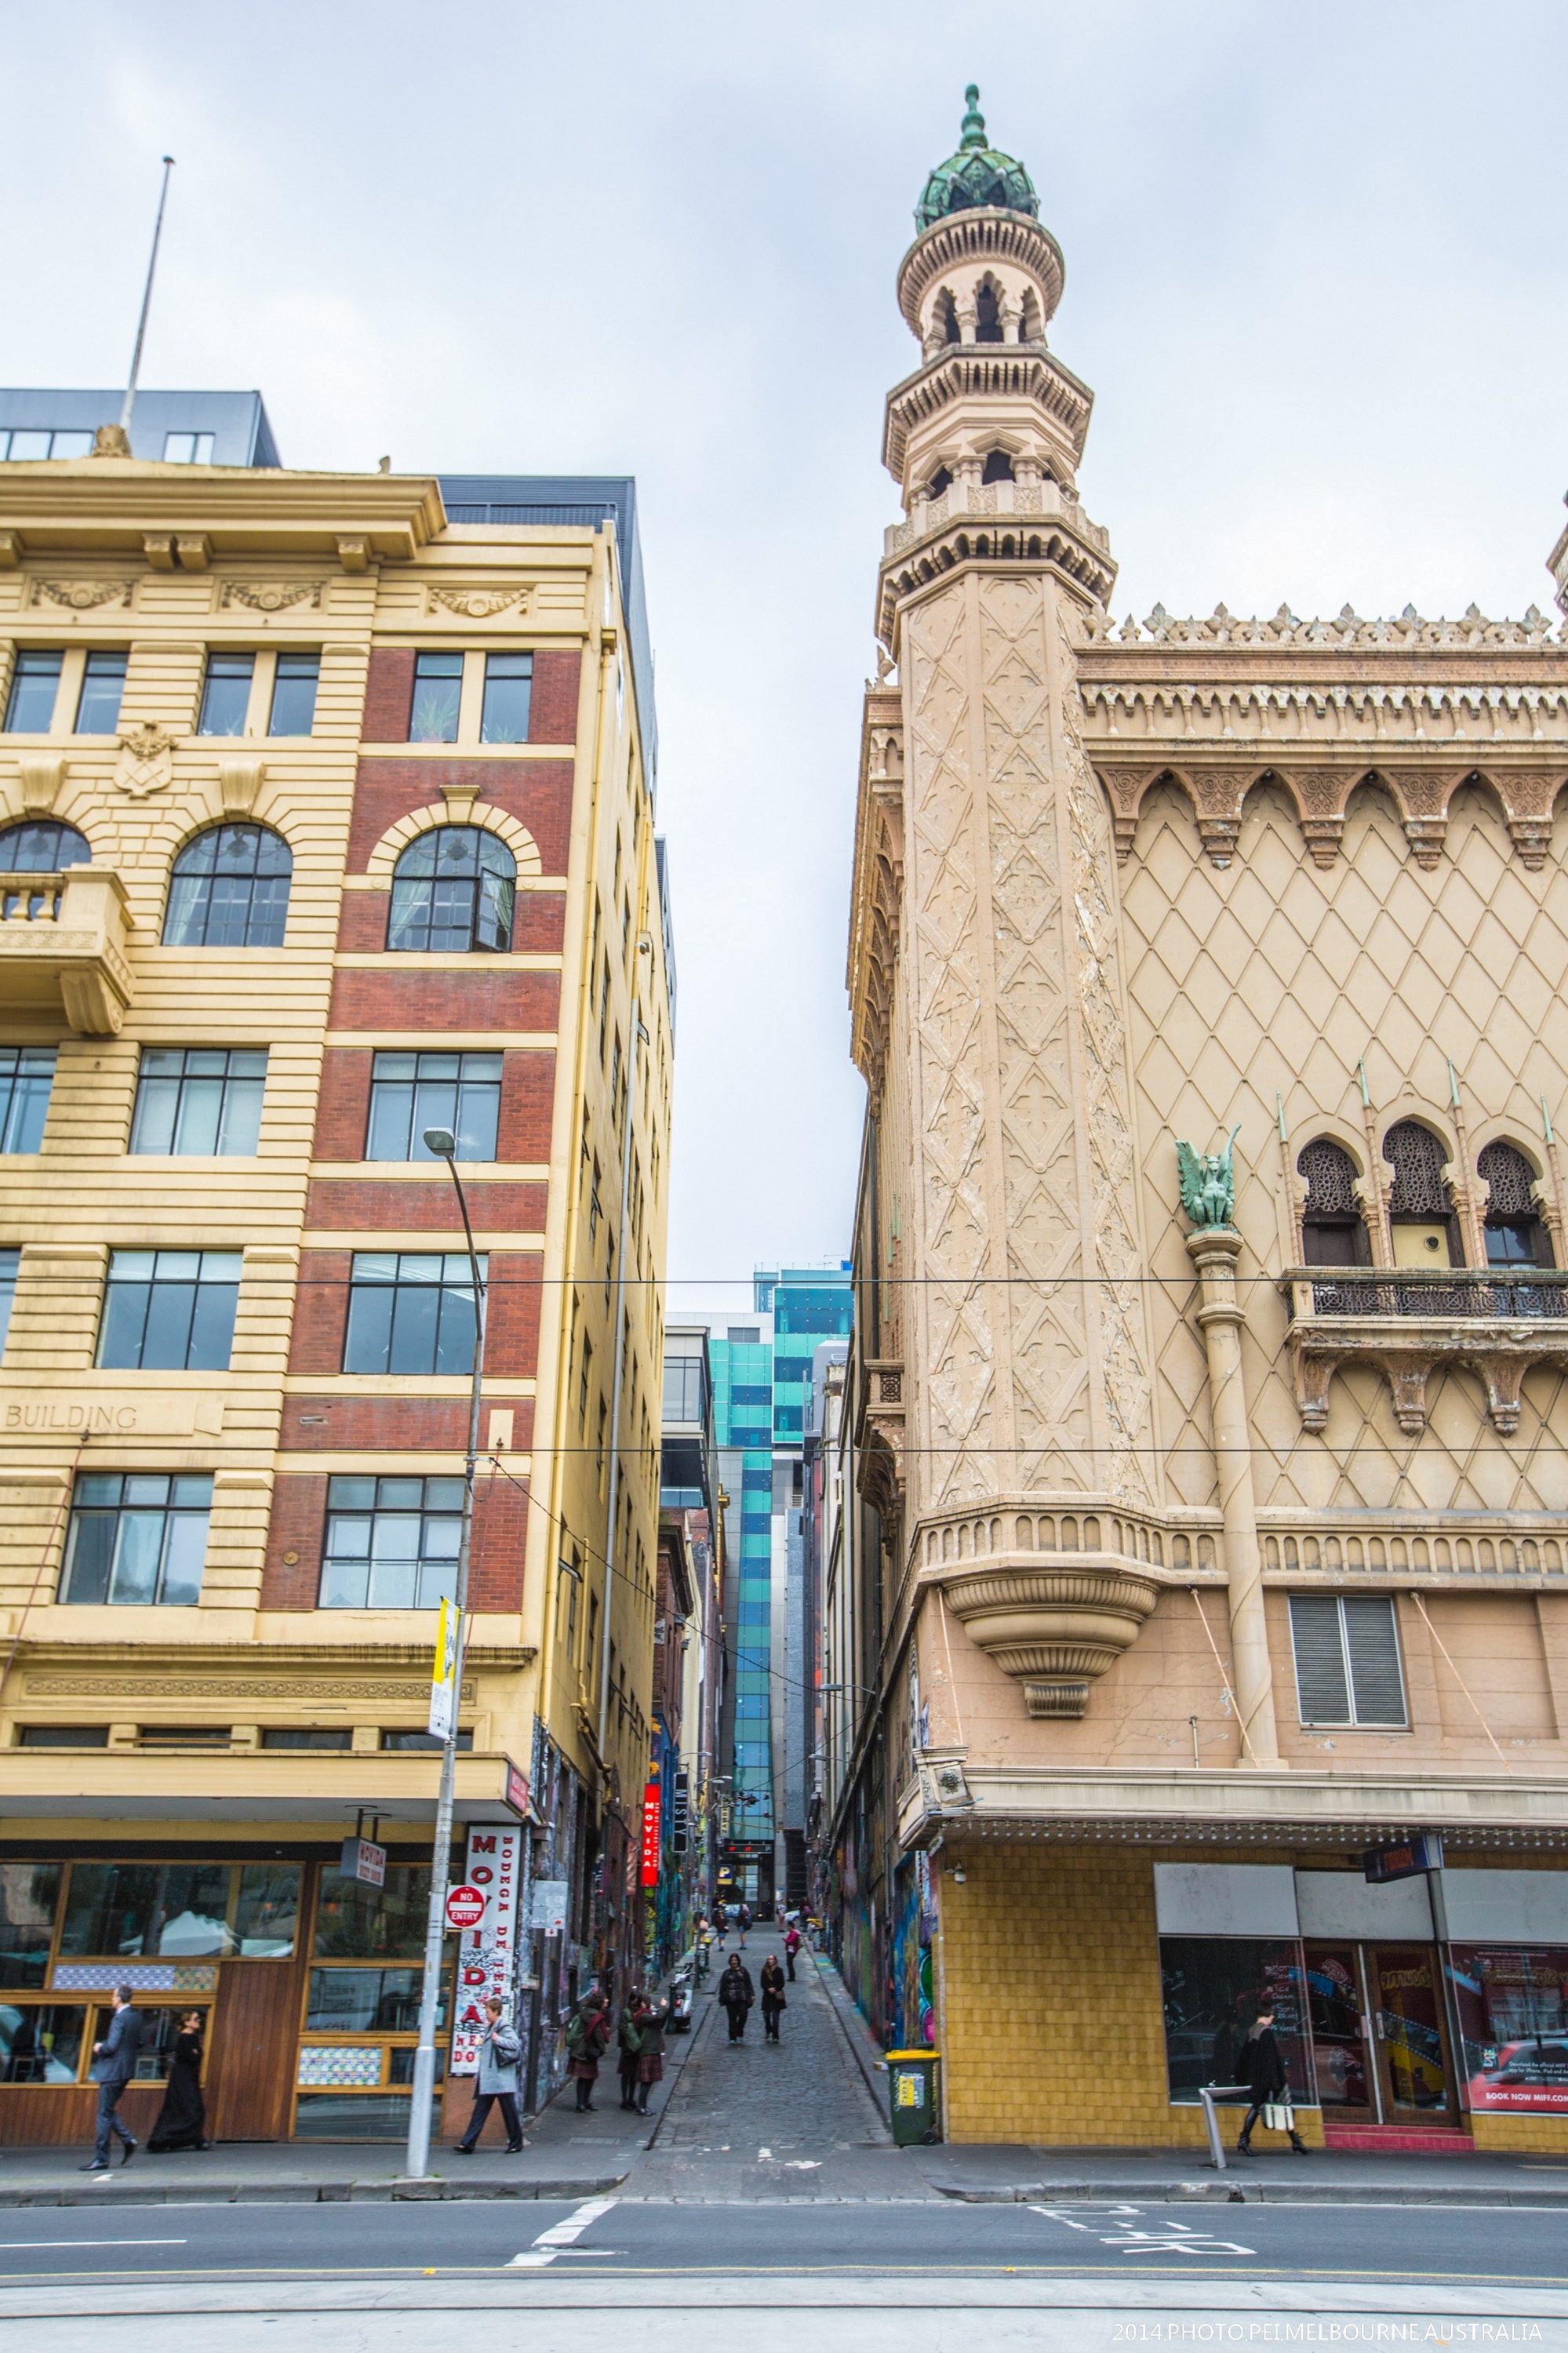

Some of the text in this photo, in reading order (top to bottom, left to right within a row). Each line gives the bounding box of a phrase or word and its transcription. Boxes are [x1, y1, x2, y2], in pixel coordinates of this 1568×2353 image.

[5, 1405, 137, 1429] BUILDING
[675, 1789, 687, 1835] MISTY
[643, 1802, 654, 1867] MOVIDA
[498, 1836, 513, 1912] BODEGA
[719, 1866, 730, 1878] P
[460, 1893, 474, 1902] NO
[451, 1911, 479, 1921] ENTRY
[459, 1835, 497, 2024] MOIDA
[496, 1926, 508, 1948] DE
[1486, 2092, 1509, 2100] BOOK
